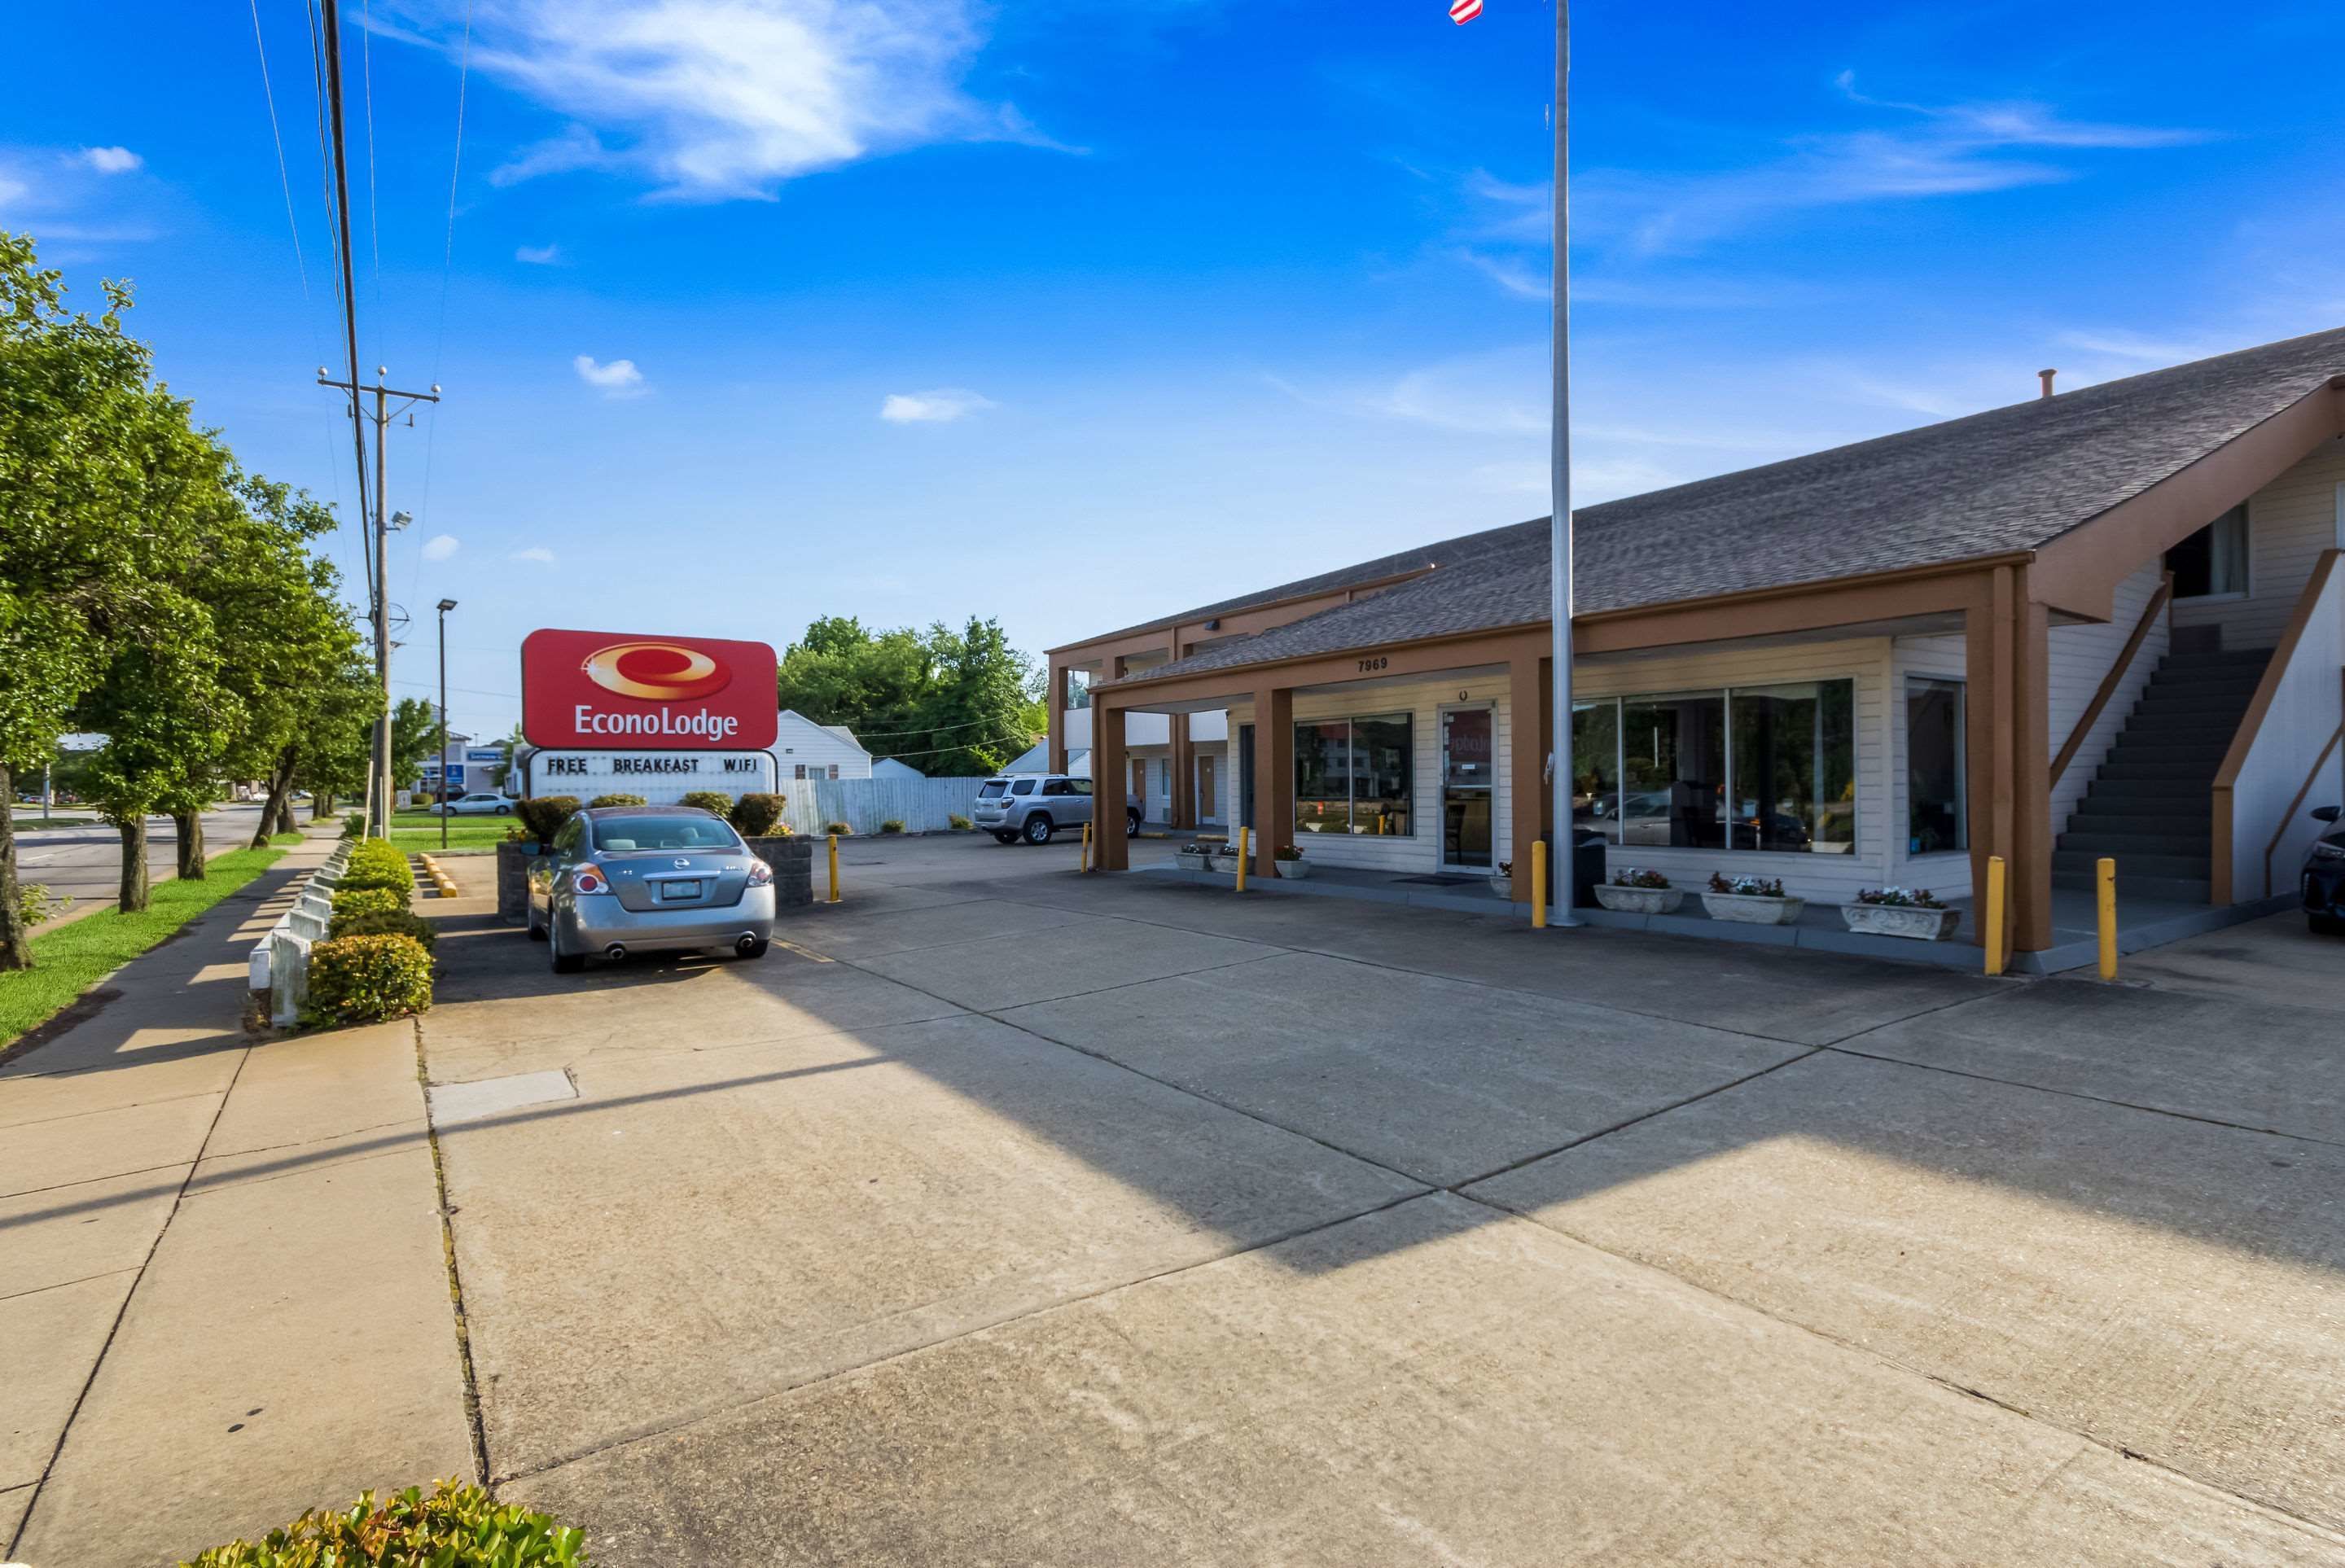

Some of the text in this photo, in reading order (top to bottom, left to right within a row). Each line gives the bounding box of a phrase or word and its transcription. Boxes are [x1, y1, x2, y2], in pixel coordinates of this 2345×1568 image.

[1358, 657, 1388, 672] 7969
[548, 758, 757, 773] FREE BREAKFAST WIFI
